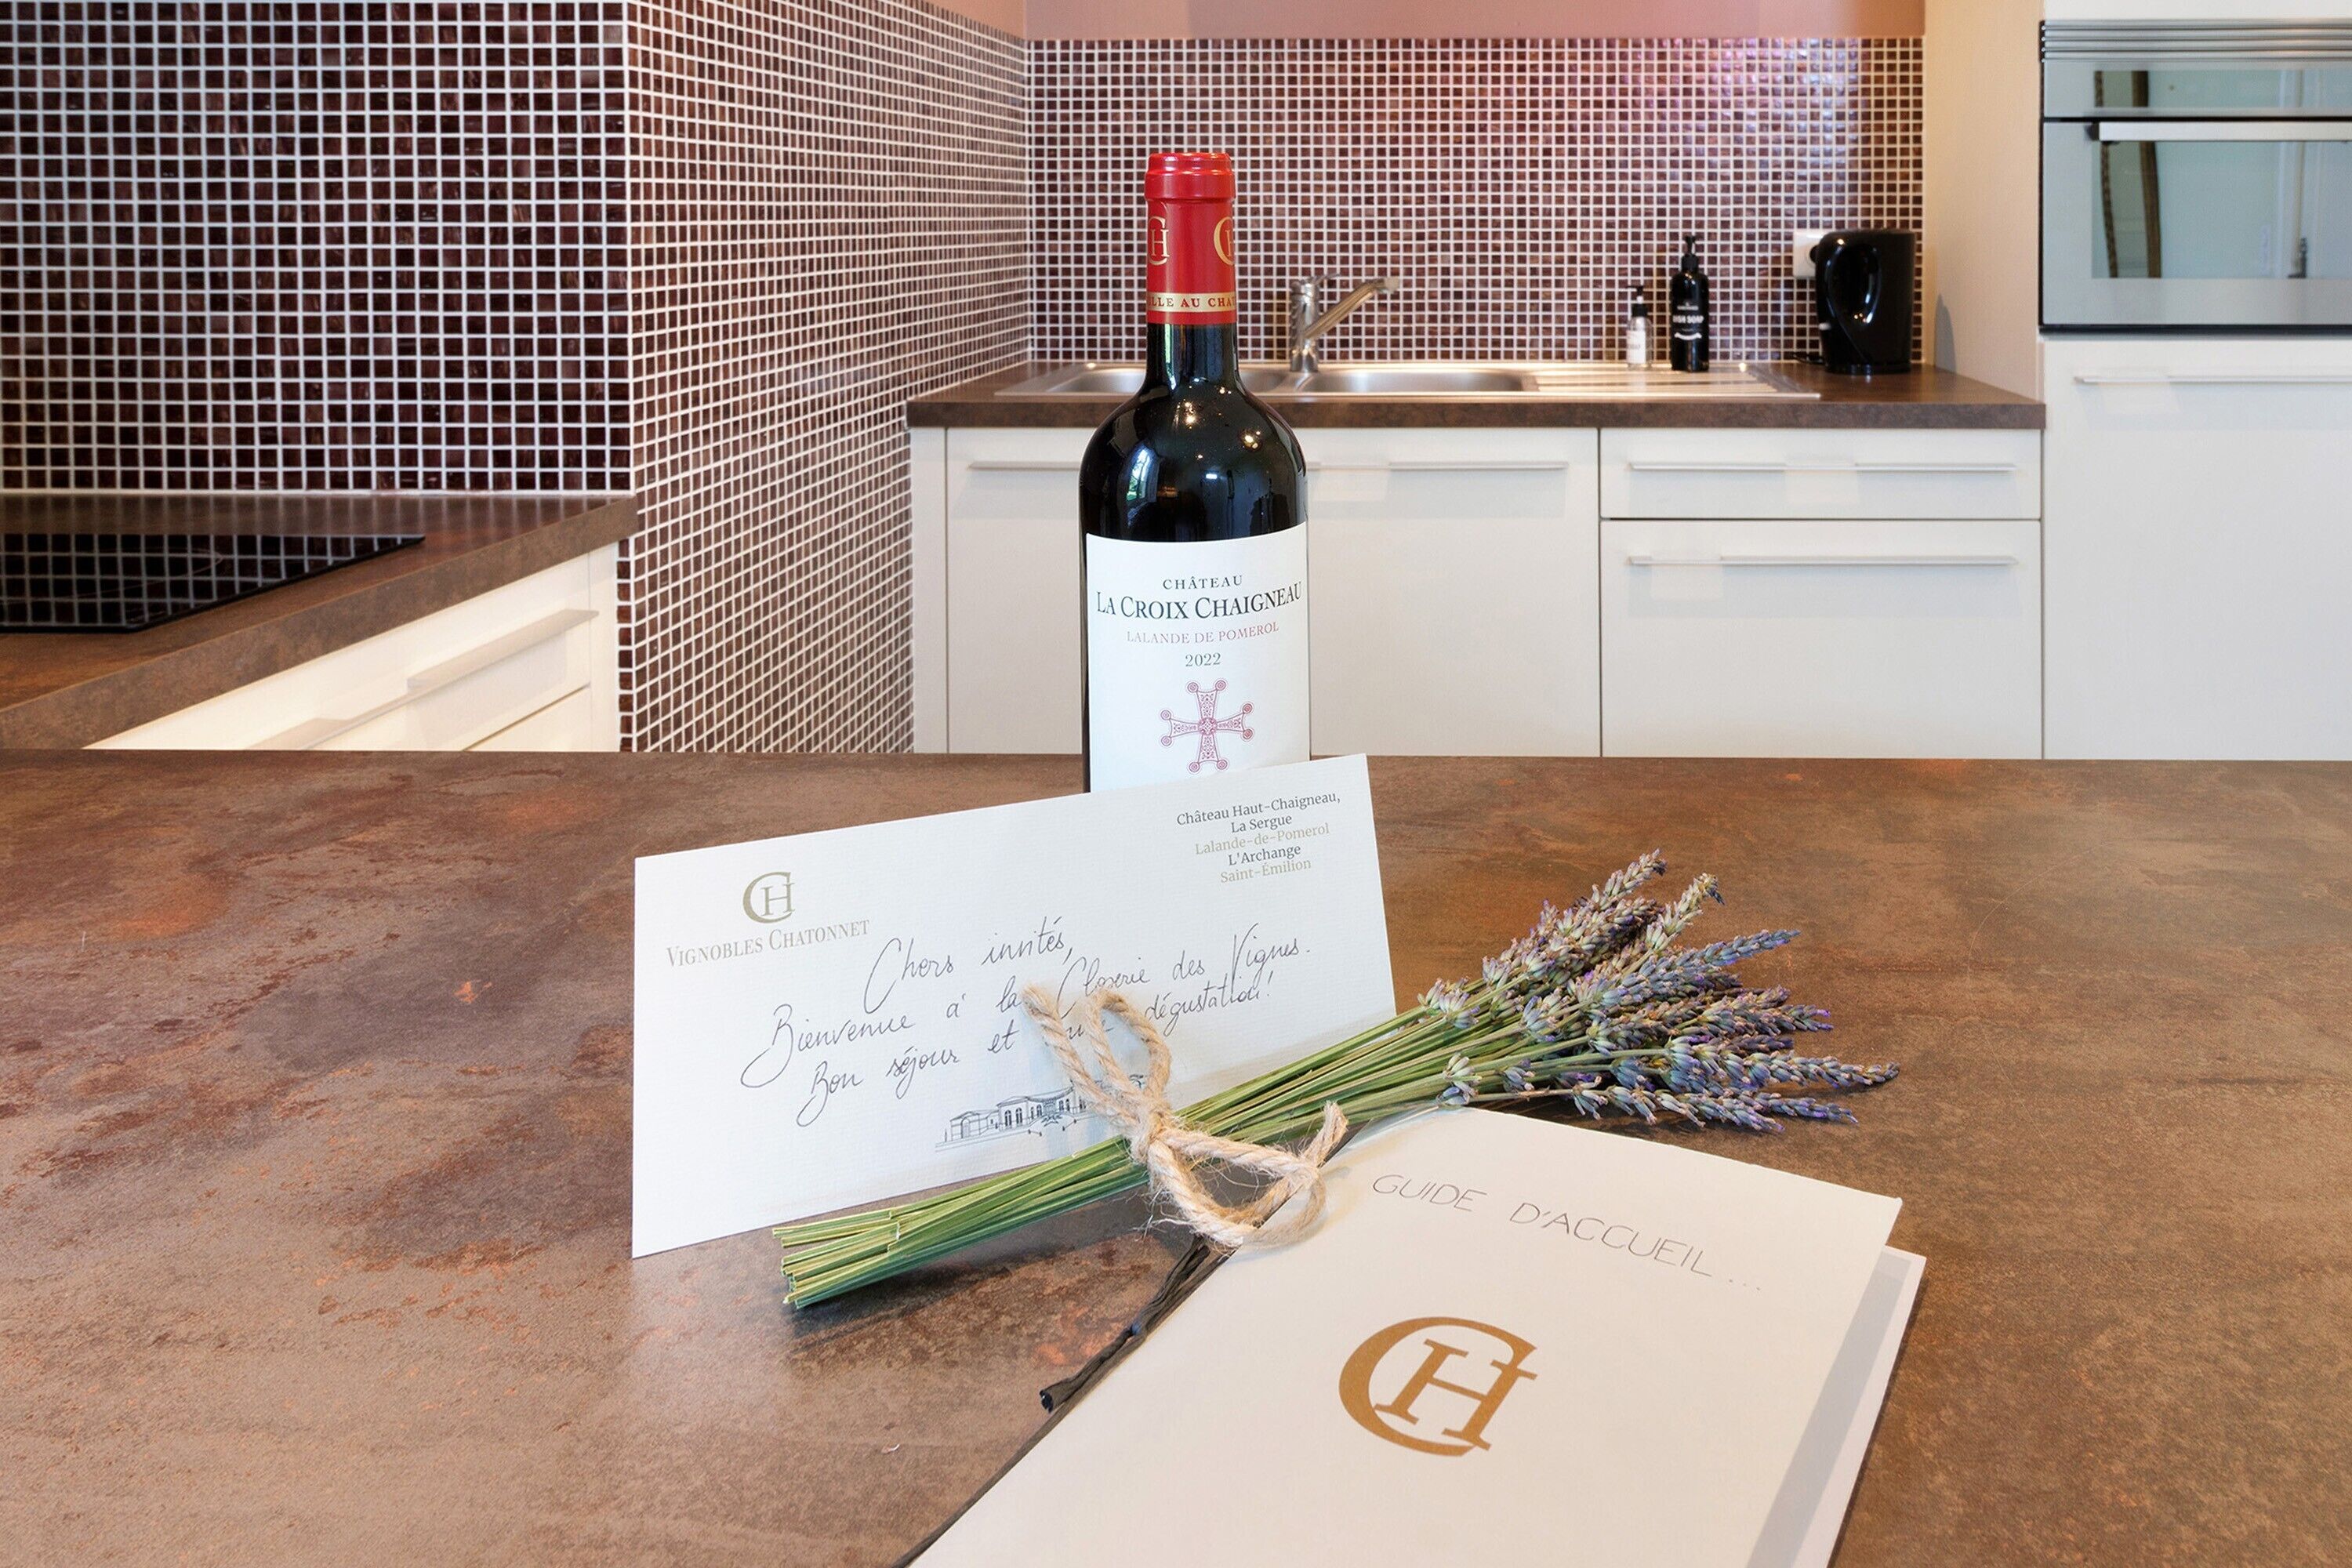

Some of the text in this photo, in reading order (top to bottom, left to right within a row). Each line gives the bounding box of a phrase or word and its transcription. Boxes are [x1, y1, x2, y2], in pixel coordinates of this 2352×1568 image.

[1181, 298, 1200, 307] AU
[1687, 315, 1704, 324] SOAP
[1162, 575, 1243, 590] CHÂTEAU
[1097, 581, 1303, 619] LA CROIX CHAIGNEAU
[1127, 622, 1279, 644] LALANDE DE POMEROL
[1185, 652, 1221, 667] 2022
[1177, 792, 1341, 826] Château Haut-Chaigneau,
[1231, 814, 1293, 833] La Sergue
[1195, 822, 1330, 855] Lalande-de-Pomerol
[1228, 844, 1301, 866] L'Archange
[1220, 859, 1312, 884] Saint-Émilion
[742, 871, 796, 924] CH
[863, 938, 955, 1014] Chers
[740, 1003, 916, 1088] Bienvenue
[995, 975, 1022, 1013] la
[1172, 949, 1205, 981] des
[796, 1060, 864, 1127] Bon
[885, 1045, 961, 1100] séjour
[987, 1018, 1021, 1054] et
[1372, 1174, 1488, 1212] GUIDE
